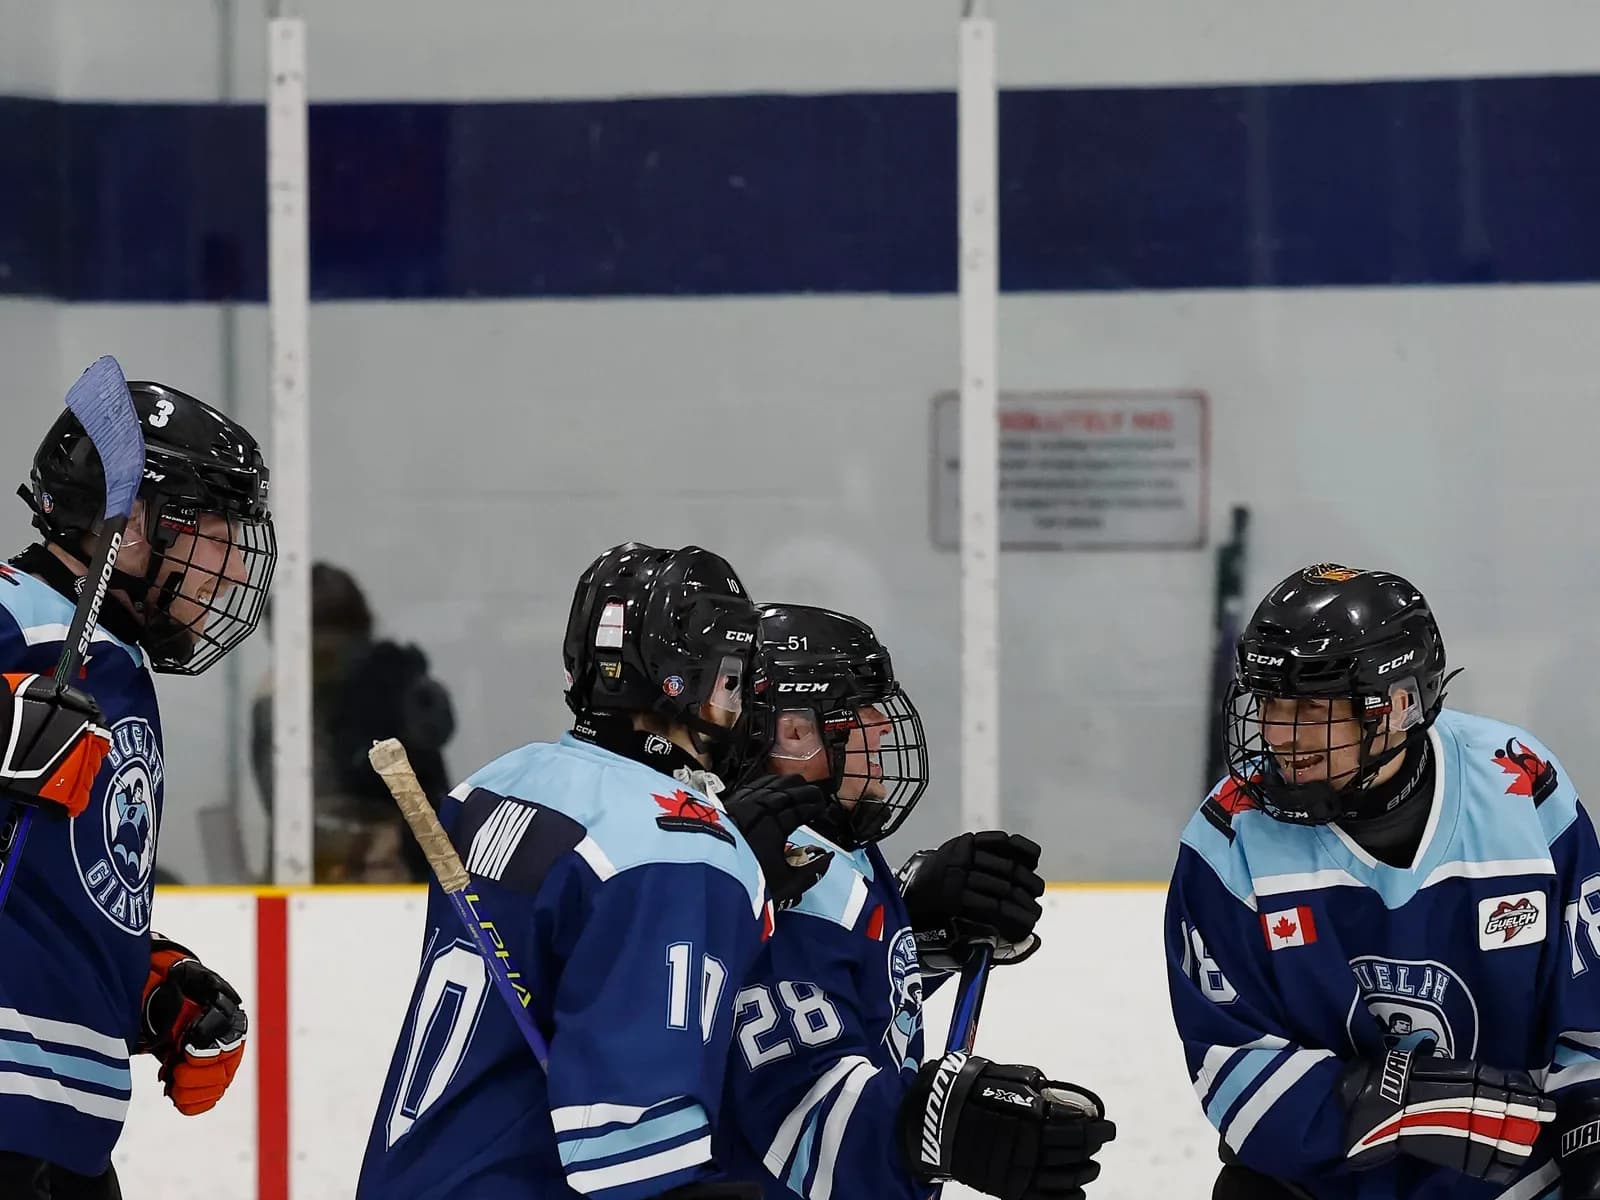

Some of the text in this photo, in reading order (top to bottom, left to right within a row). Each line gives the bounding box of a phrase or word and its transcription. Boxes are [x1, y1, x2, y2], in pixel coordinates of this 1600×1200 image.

[149, 400, 176, 428] 3
[78, 532, 122, 654] SHERWOOD
[726, 577, 740, 594] 10
[725, 630, 754, 643] CCM
[787, 636, 809, 650] 51
[1247, 652, 1285, 667] CCM
[1378, 651, 1415, 675] CCM
[778, 683, 829, 692] CCM
[575, 724, 597, 738] CCM
[1486, 911, 1538, 934] GUELPH
[464, 894, 532, 1009] LPHA
[665, 941, 729, 1045] 10
[1352, 961, 1450, 1005] UELPH
[732, 981, 844, 1072] 28
